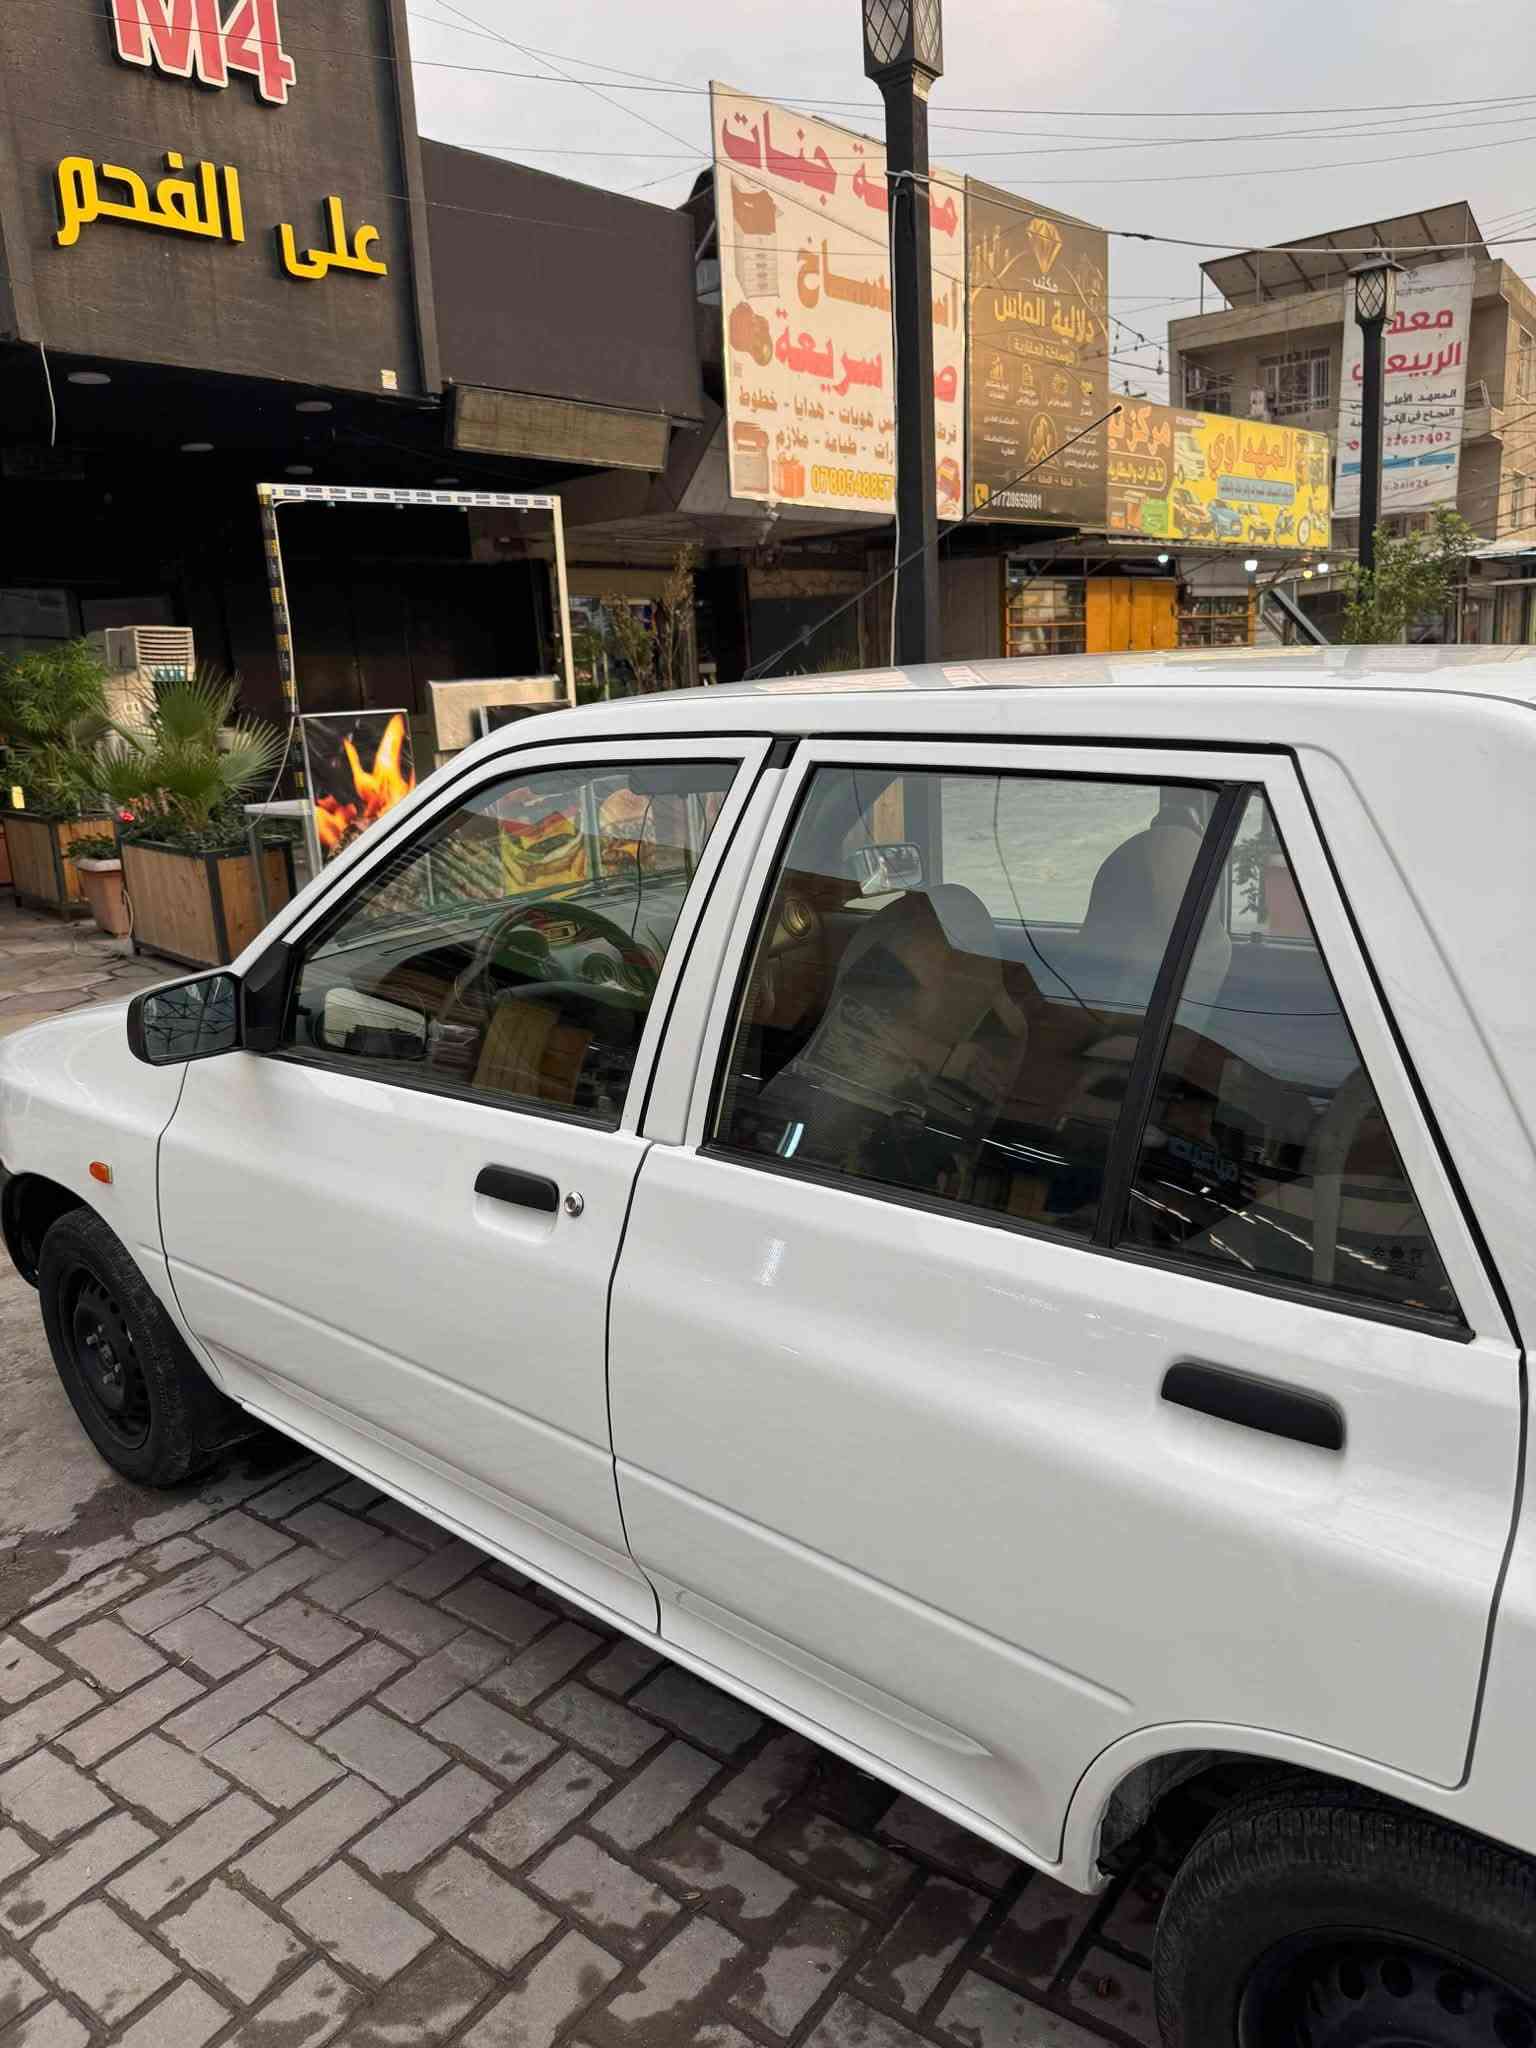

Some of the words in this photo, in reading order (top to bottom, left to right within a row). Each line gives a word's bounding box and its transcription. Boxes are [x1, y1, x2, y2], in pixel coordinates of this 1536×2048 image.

[111, 0, 297, 105] M4
[55, 151, 246, 247] الفحم
[722, 110, 838, 206] جنات
[276, 194, 389, 280] على
[775, 307, 882, 396] سريعة
[994, 291, 1046, 327] الماس
[1127, 405, 1171, 456] مركز
